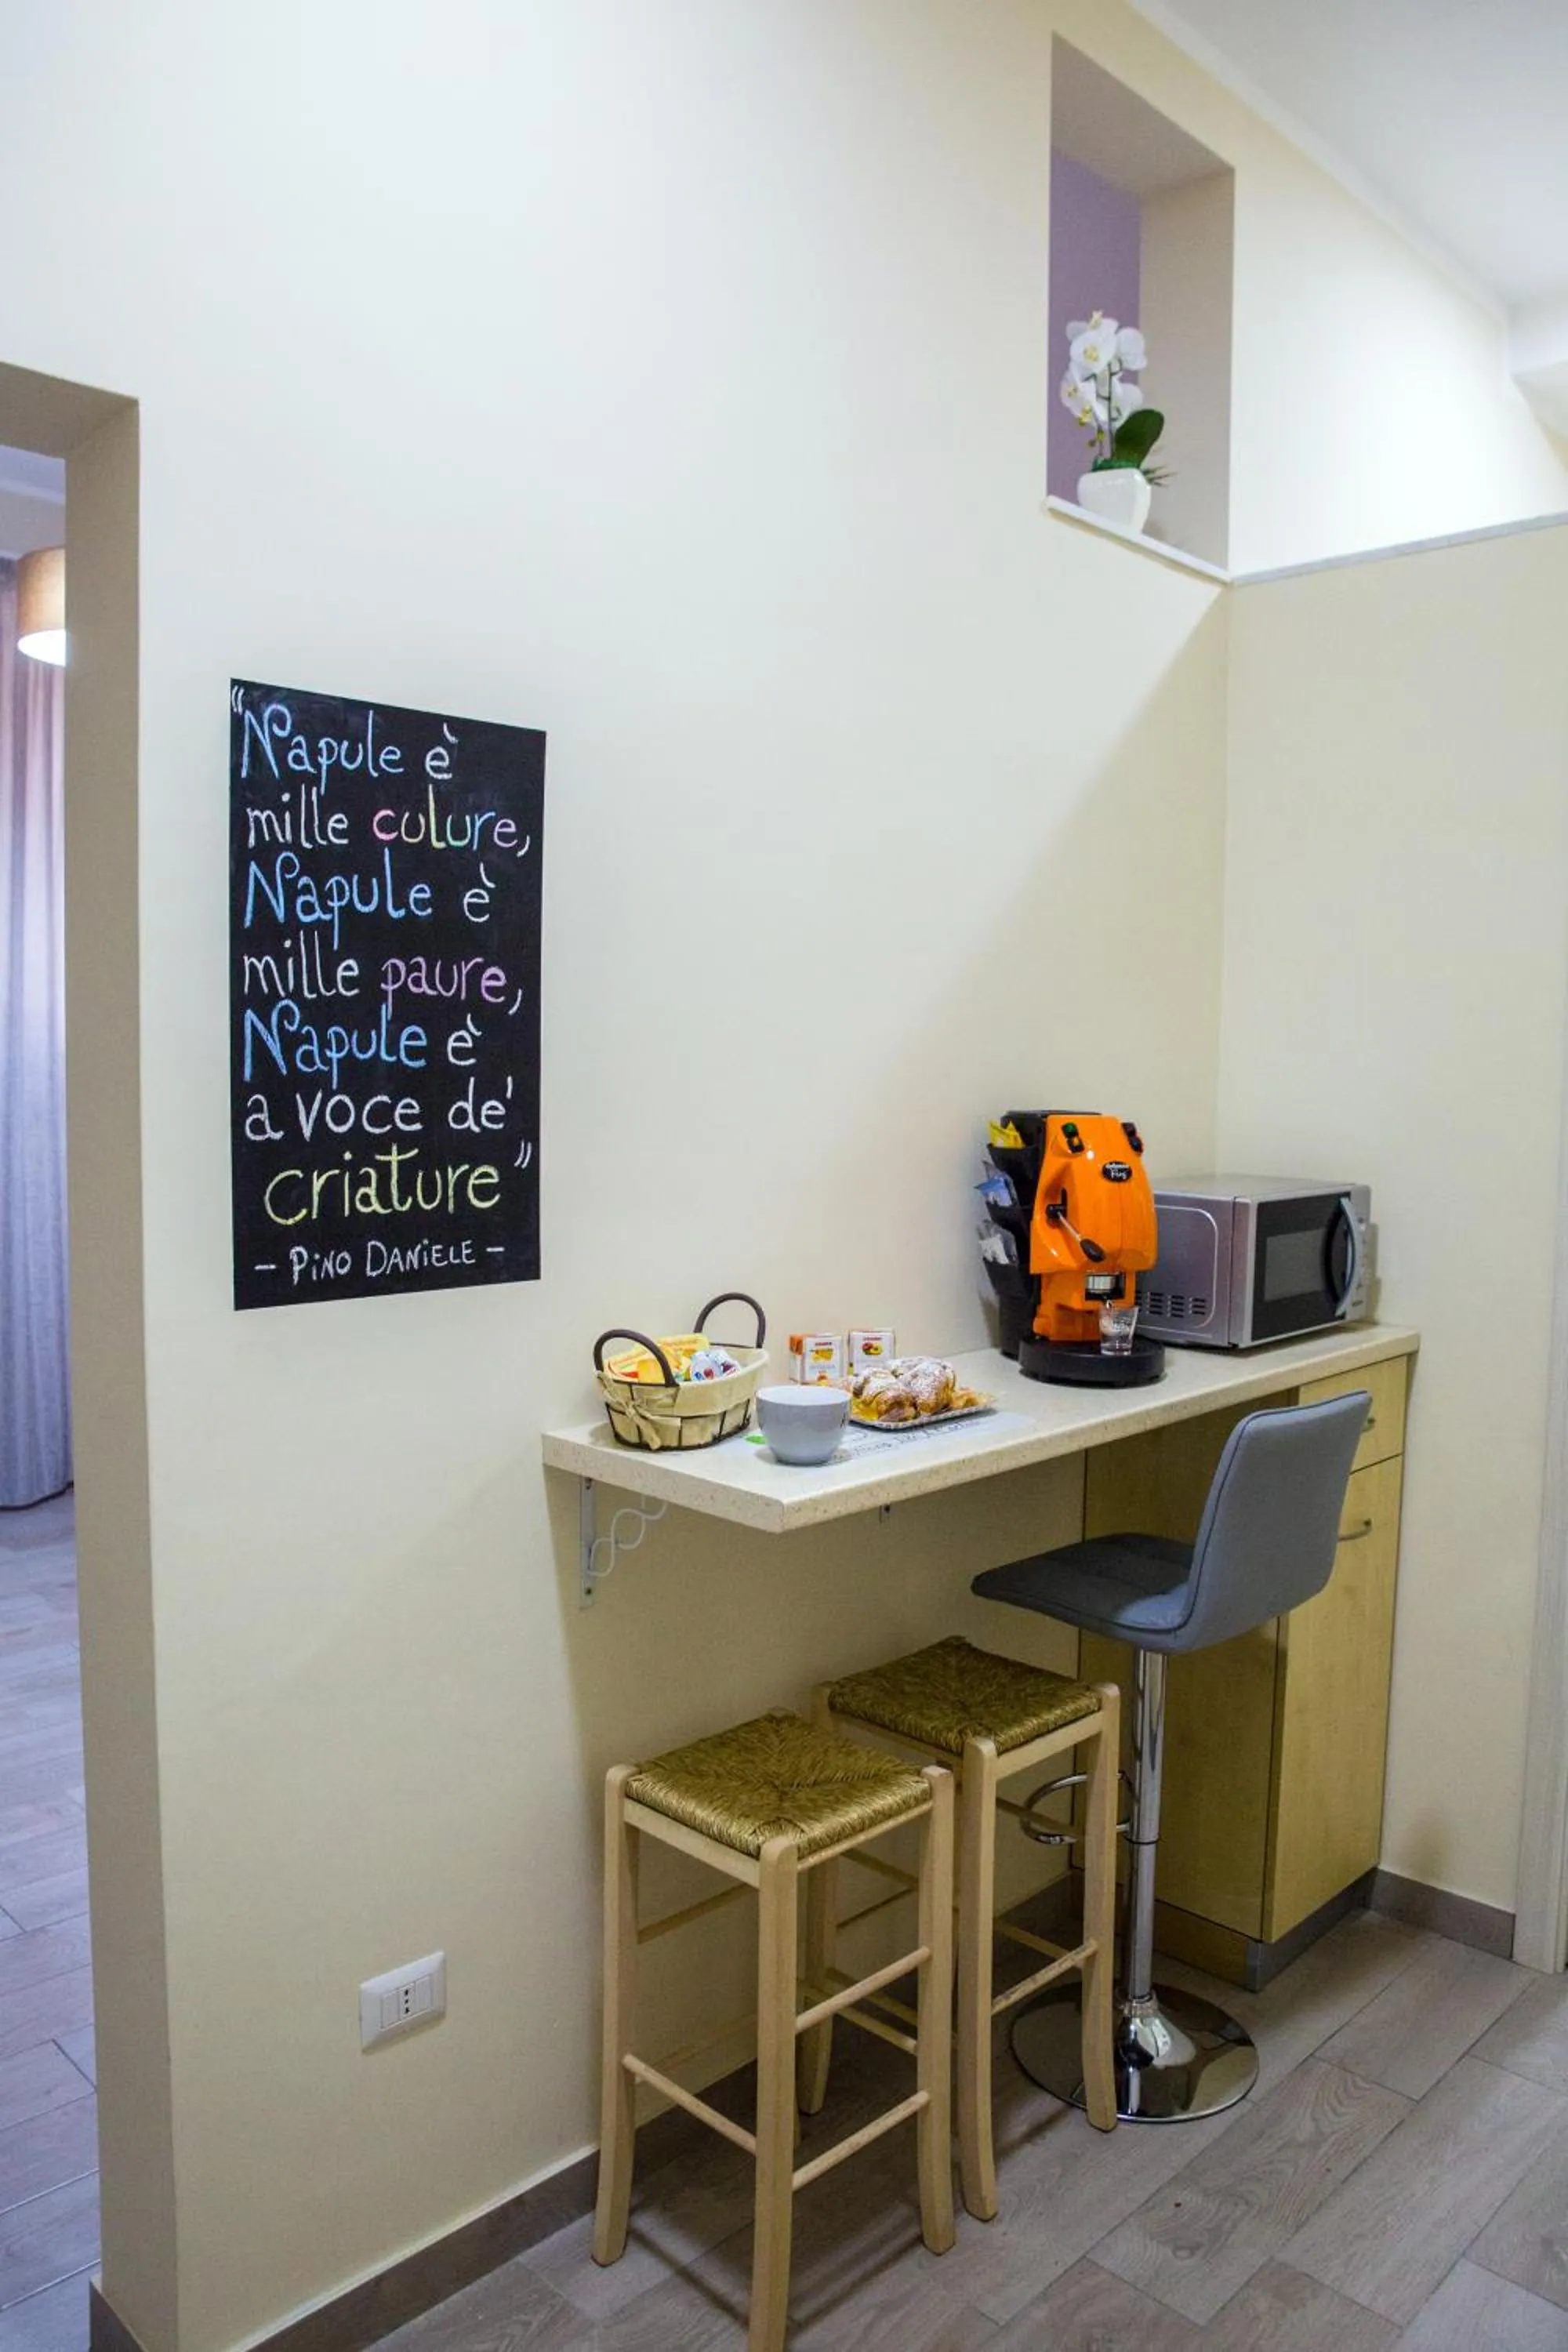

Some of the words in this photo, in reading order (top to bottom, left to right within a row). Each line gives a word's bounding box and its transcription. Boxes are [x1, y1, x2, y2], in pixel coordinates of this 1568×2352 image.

[425, 722, 459, 780] è
[246, 784, 350, 849] mille
[372, 784, 531, 857] culure,
[244, 847, 433, 950] Napule
[463, 862, 495, 923] è
[243, 930, 361, 999] mille
[380, 956, 523, 1019] paure,
[244, 999, 427, 1090] Napule
[245, 1094, 285, 1141] a
[296, 1089, 424, 1142] voce
